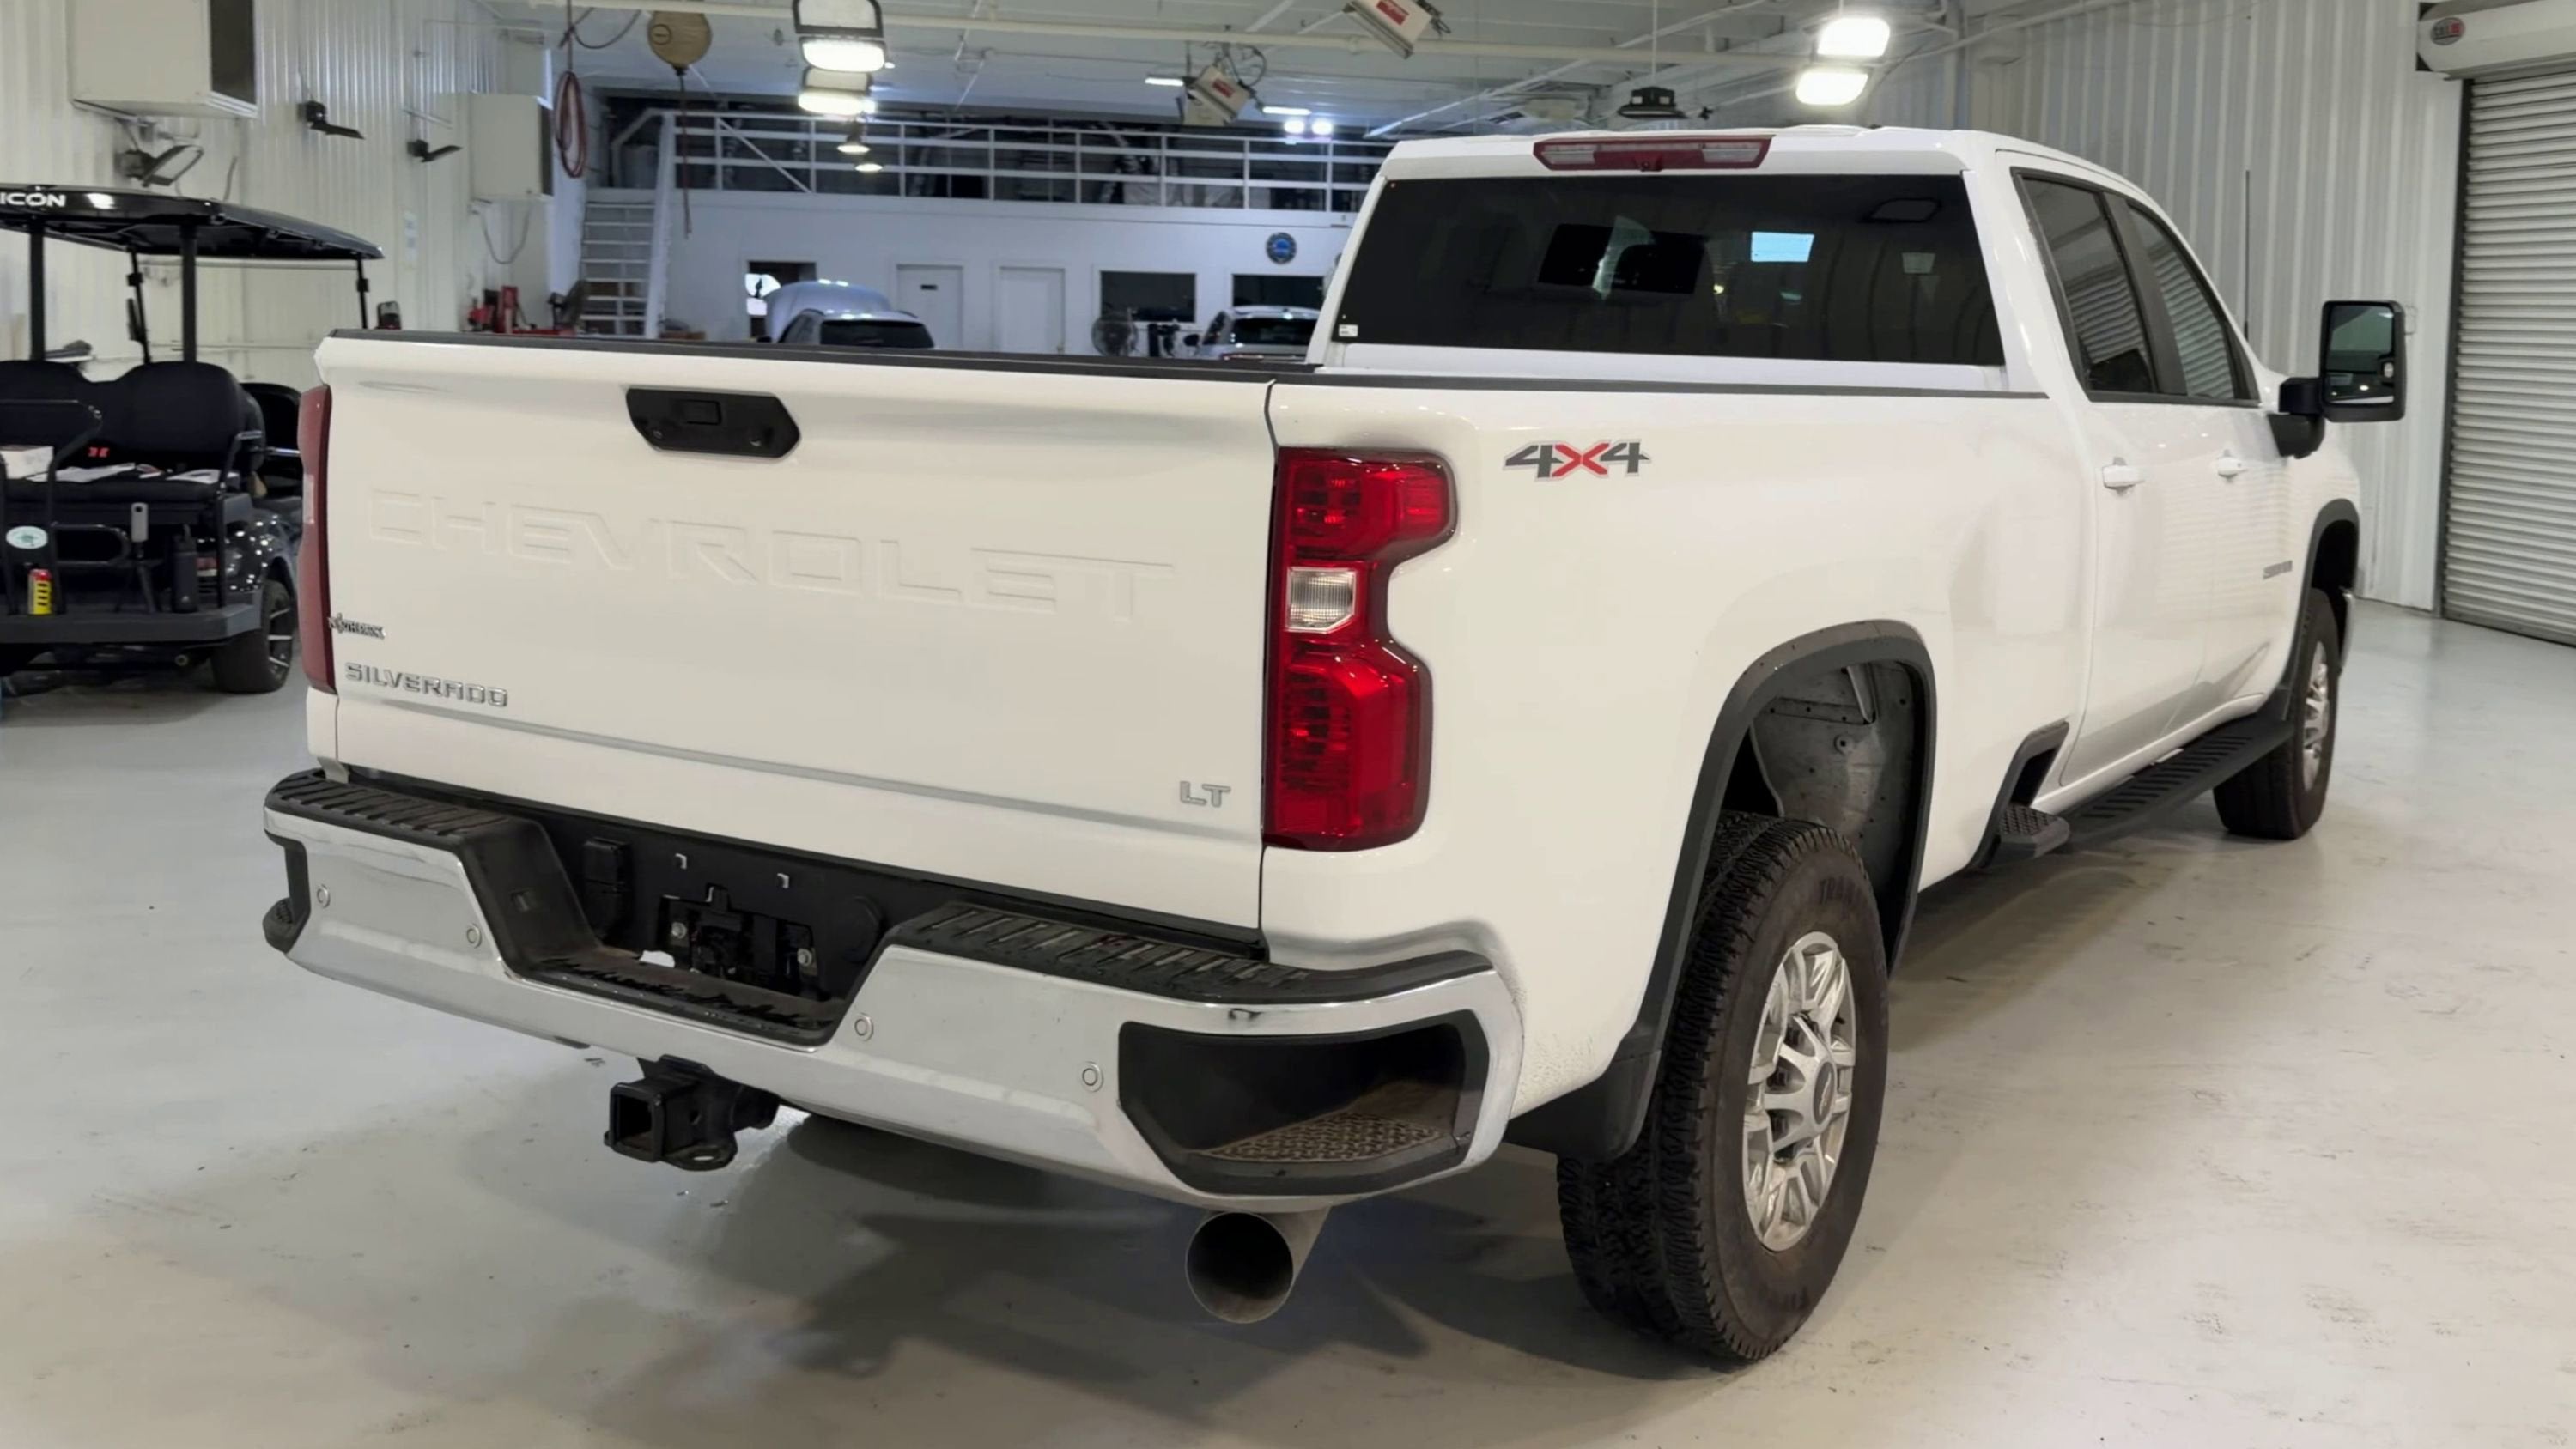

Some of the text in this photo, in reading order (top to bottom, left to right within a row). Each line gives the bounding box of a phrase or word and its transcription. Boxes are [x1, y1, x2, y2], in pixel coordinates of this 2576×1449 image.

[0, 192, 66, 207] ICON
[368, 488, 1175, 625] CHEVROLET
[344, 662, 508, 707] SILVERADO
[1180, 780, 1231, 808] LT
